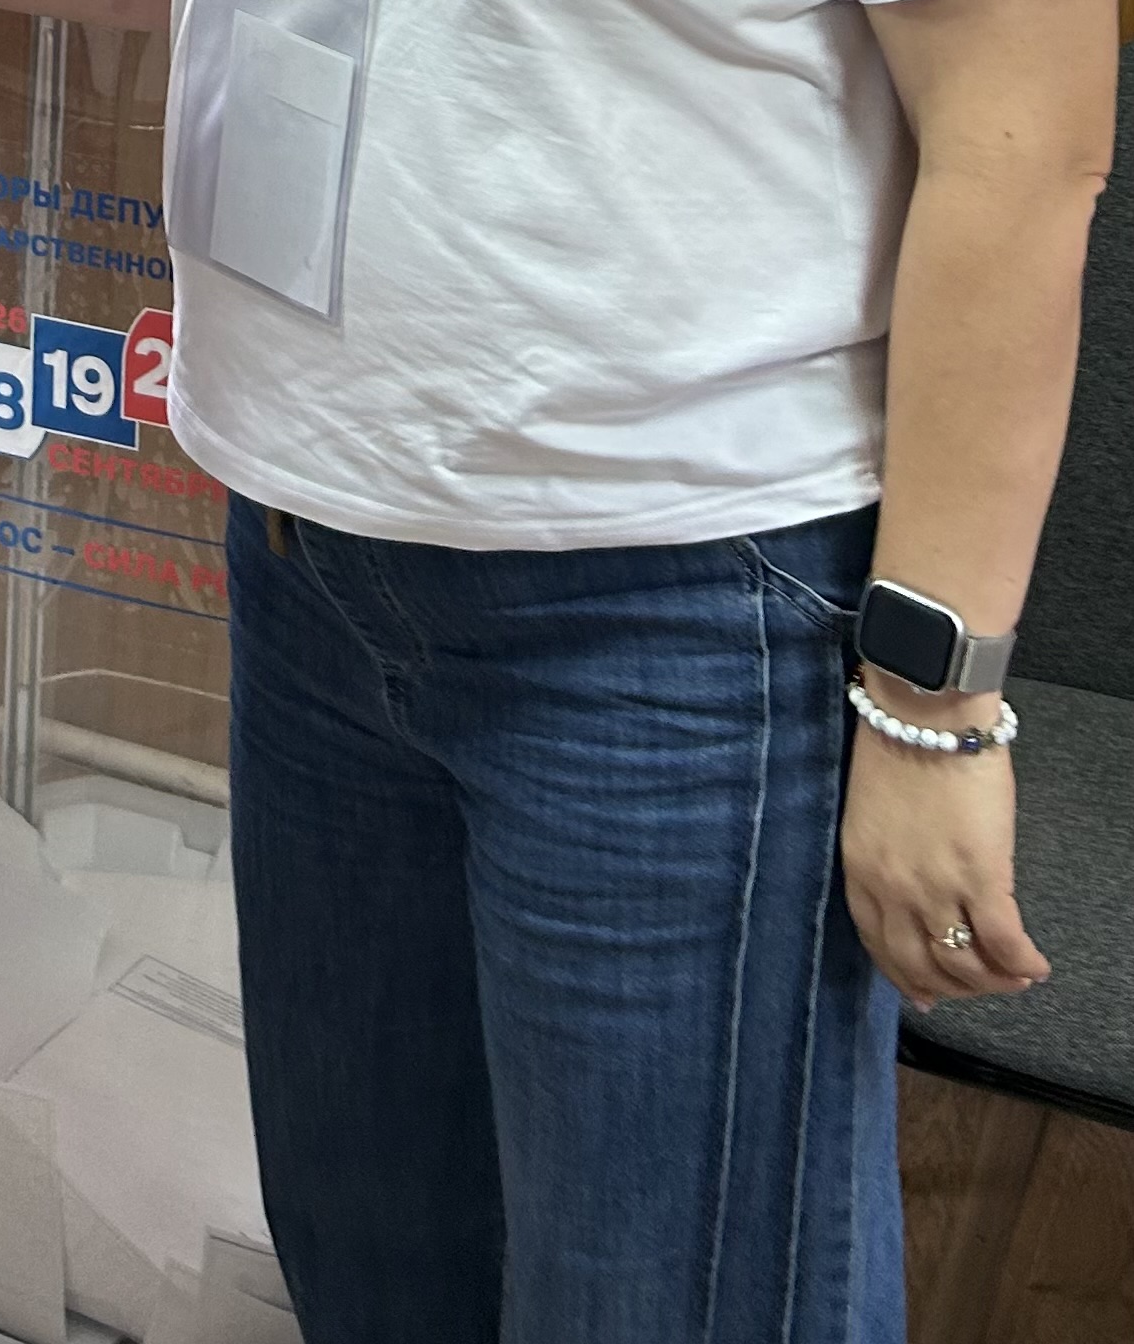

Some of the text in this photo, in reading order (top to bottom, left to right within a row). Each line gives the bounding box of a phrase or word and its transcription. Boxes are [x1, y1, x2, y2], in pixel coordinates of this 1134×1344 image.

[70, 188, 163, 229] ДЕПУ
[43, 349, 115, 416] 19
[83, 542, 182, 588] СИЛА
